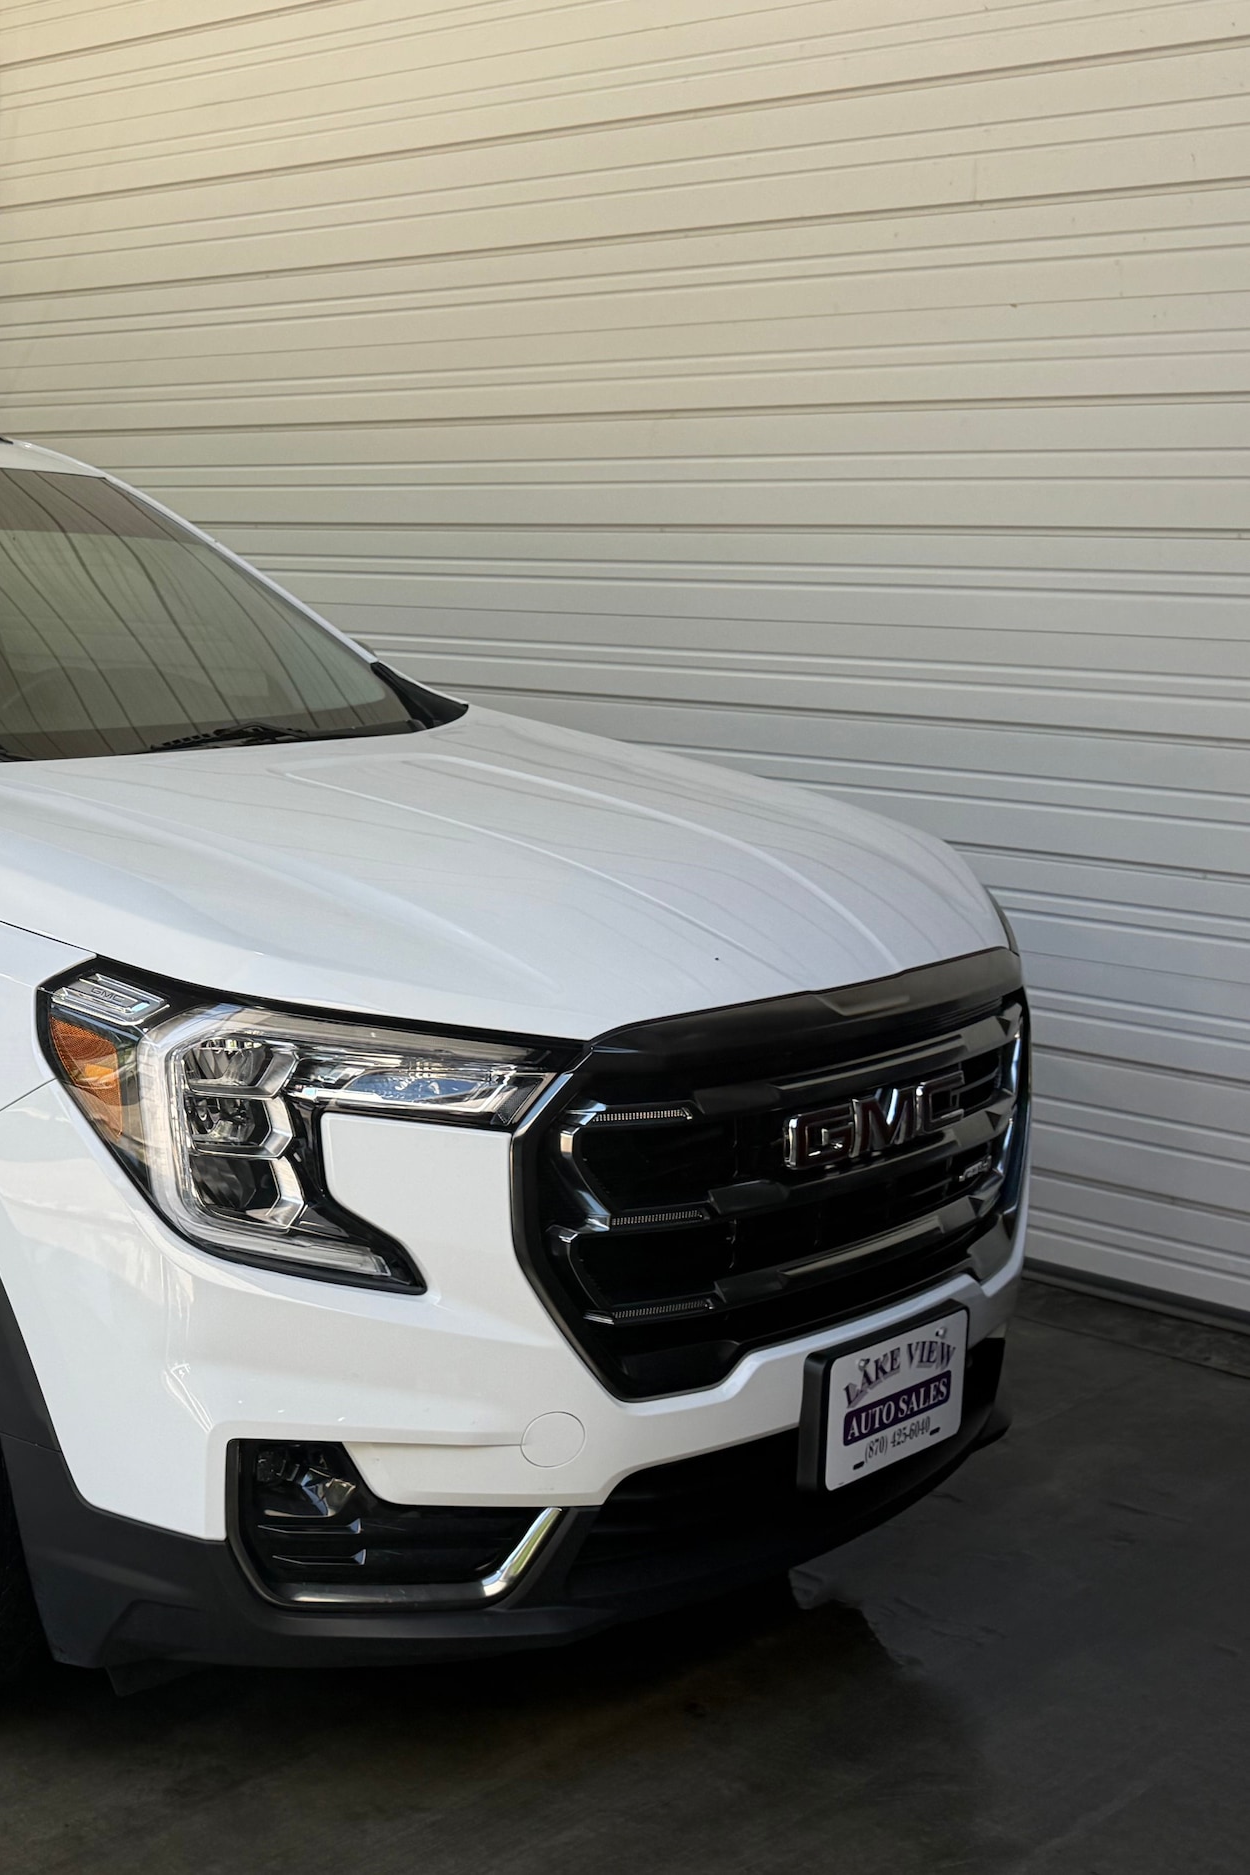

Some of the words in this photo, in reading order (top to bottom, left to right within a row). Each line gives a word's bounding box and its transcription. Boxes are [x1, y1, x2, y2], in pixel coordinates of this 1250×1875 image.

[91, 987, 125, 1001] GMC
[783, 1071, 965, 1170] GMC
[843, 1348, 901, 1408] LAKE
[907, 1340, 956, 1371] VIEW
[847, 1401, 895, 1440] AUTO
[898, 1378, 947, 1418] SALES
[865, 1435, 888, 1463] (870)
[890, 1416, 931, 1448] 425-6040
